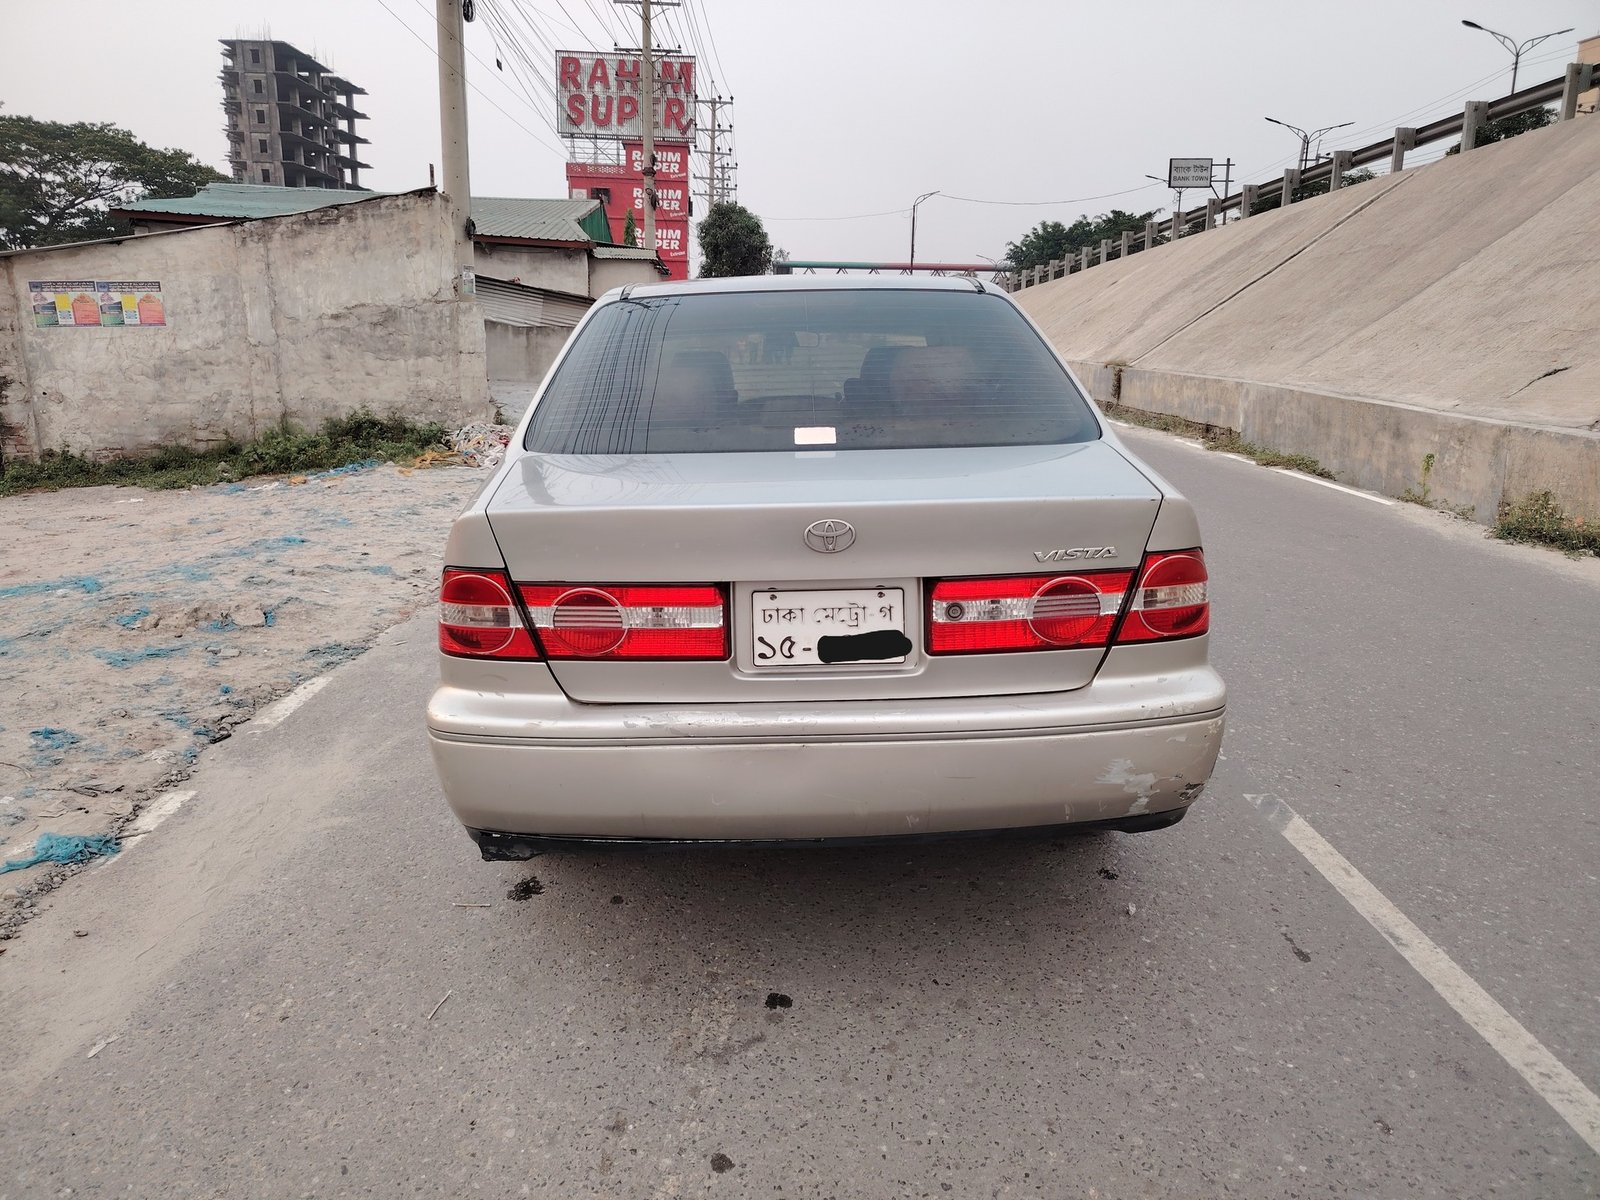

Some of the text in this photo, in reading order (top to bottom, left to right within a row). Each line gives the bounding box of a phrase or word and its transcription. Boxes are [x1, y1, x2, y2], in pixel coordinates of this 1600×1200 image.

[559, 56, 693, 94] RAHM
[631, 150, 681, 163] RHIM
[632, 161, 679, 173] SPER
[632, 187, 682, 200] RHIM
[635, 227, 681, 240] RHIM
[636, 239, 680, 250] SPER
[1033, 546, 1118, 563] VISTA
[761, 607, 805, 624] ঢাকা
